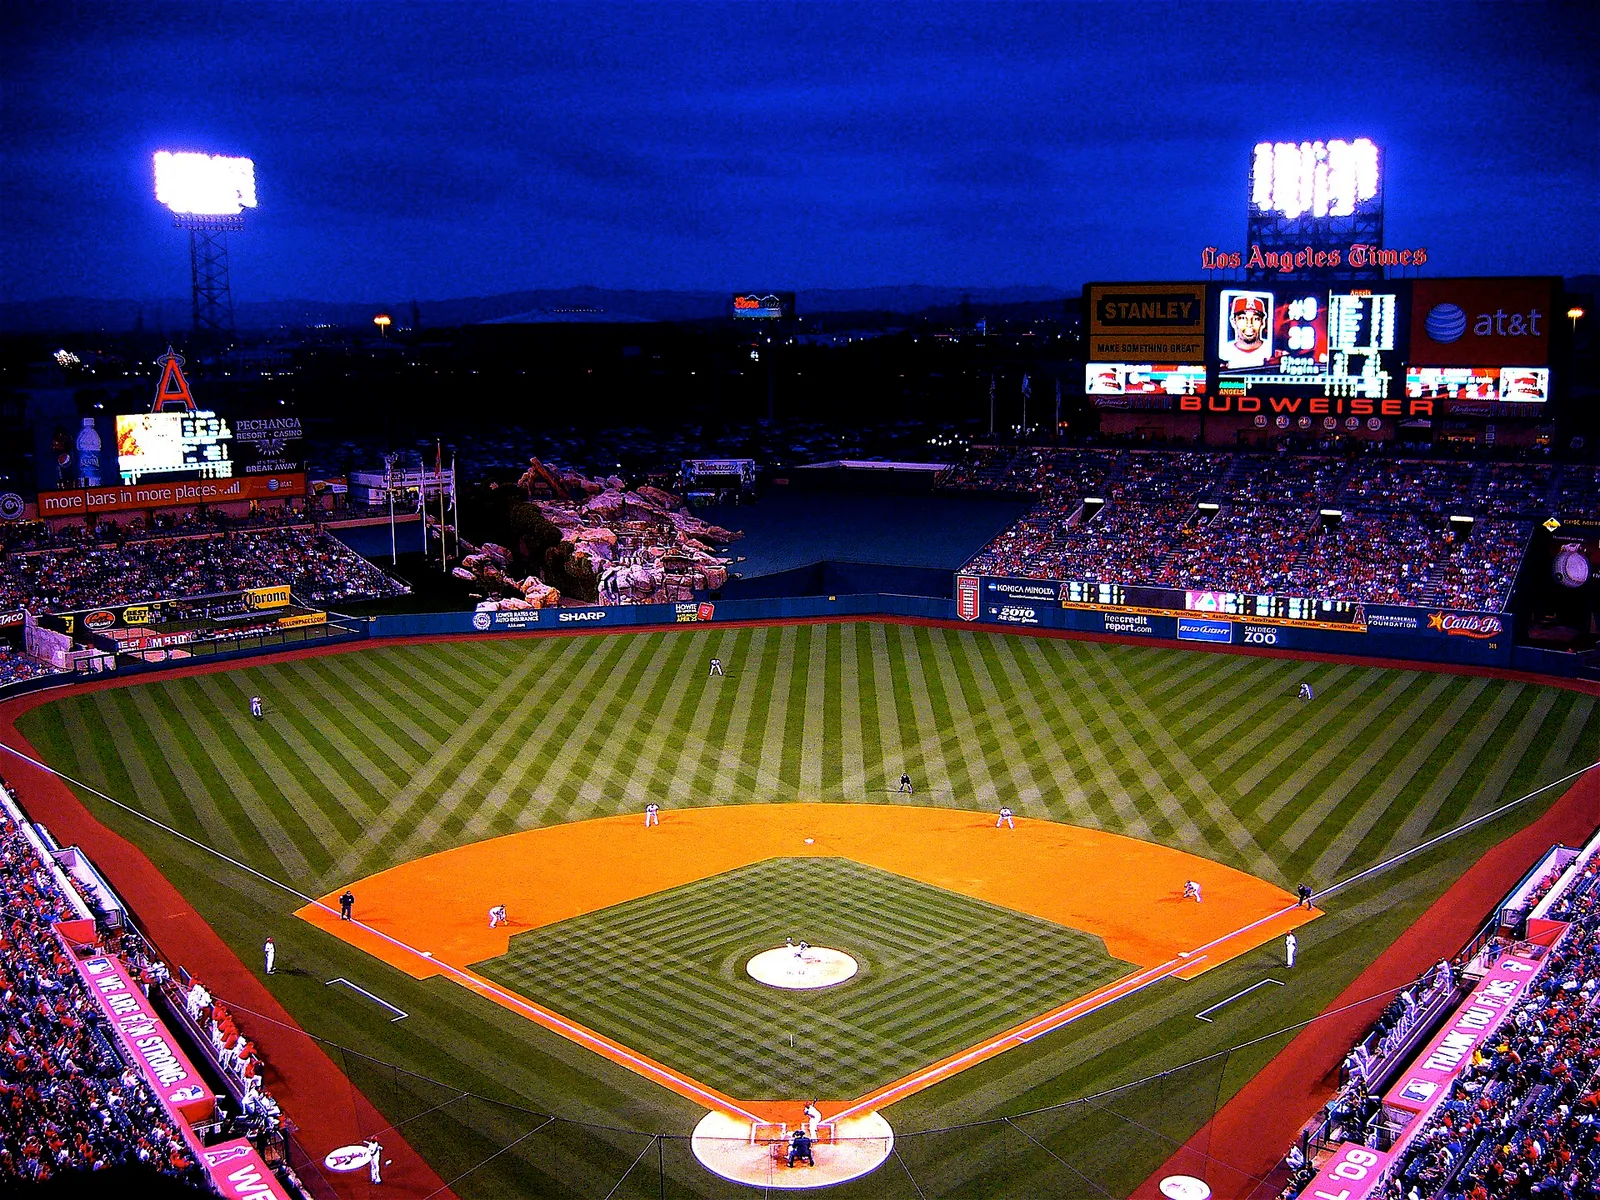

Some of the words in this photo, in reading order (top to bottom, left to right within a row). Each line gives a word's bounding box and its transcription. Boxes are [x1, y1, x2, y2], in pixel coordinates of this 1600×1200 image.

[1201, 246, 1241, 270] Los
[1244, 244, 1341, 273] Angeles
[1348, 243, 1428, 268] Times
[1104, 301, 1193, 319] STANLEY
[1473, 308, 1542, 336] at&t
[1097, 343, 1119, 353] MAKE
[1121, 343, 1168, 353] SOMETHING
[1218, 388, 1244, 397] ANGELS
[1180, 396, 1434, 415] BUDWEISER
[235, 417, 302, 431] PECHANGA
[236, 431, 267, 440] RESORT
[273, 429, 303, 438] CASINO
[245, 464, 273, 473] BREAK
[274, 462, 297, 471] AWAY
[45, 496, 83, 509] more
[86, 491, 117, 506] bars
[120, 489, 132, 503] in
[137, 488, 172, 502] more
[176, 484, 217, 502] places
[997, 584, 1024, 593] KONICA
[1024, 586, 1055, 596] MINOLTA
[244, 590, 287, 609] Corona
[558, 611, 607, 622] SHARP
[1000, 607, 1036, 617] 2010
[1104, 612, 1148, 625] freecredit
[0, 612, 24, 626] TACO
[1367, 620, 1417, 629] FOUNDATION
[1441, 614, 1479, 631] Carl's
[1479, 615, 1502, 633] Jr.
[1105, 622, 1152, 633] report.com
[1200, 625, 1230, 635] LIGHT
[1244, 625, 1258, 633] SAN
[1257, 626, 1277, 634] DIEGO
[1243, 632, 1277, 644] ZOO
[95, 973, 127, 994] WE
[104, 992, 142, 1016] ARE
[117, 1012, 160, 1038] FAN
[1421, 1028, 1479, 1072] THANK
[1455, 1005, 1497, 1030] YOU
